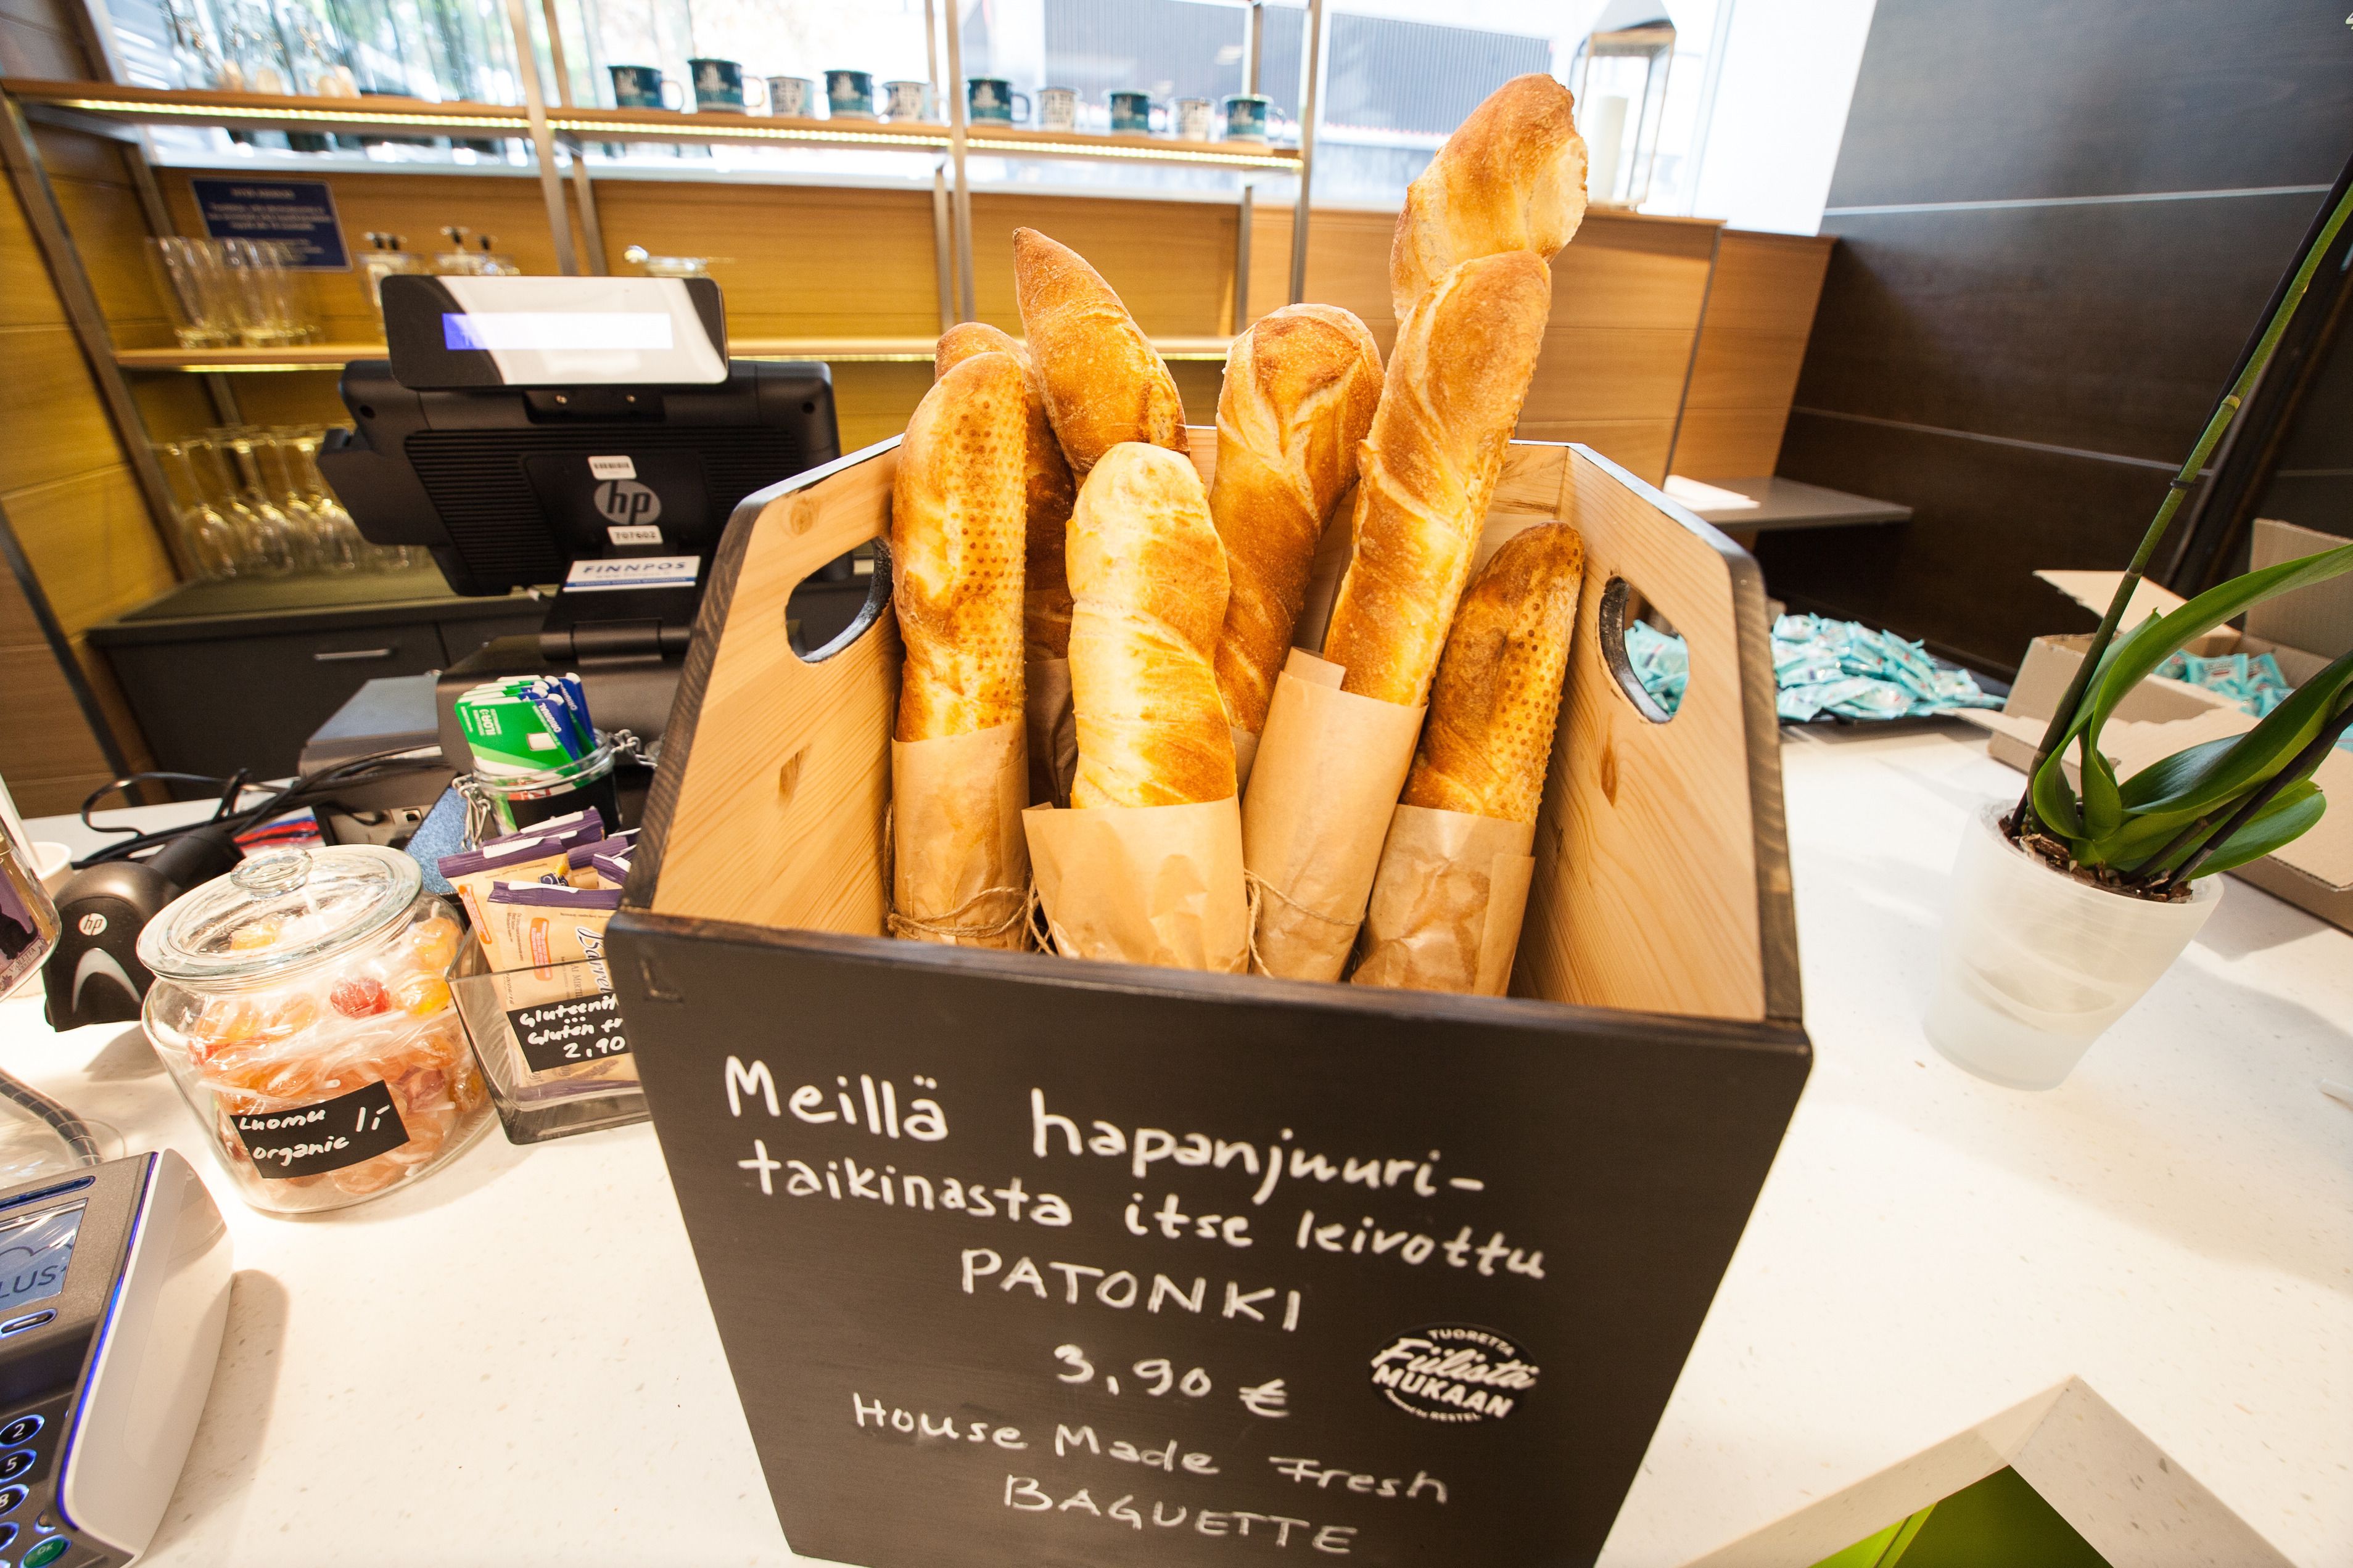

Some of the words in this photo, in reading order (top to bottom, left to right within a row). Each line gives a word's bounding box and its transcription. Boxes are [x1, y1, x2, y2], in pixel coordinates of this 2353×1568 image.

[607, 480, 651, 525] hp
[583, 562, 686, 573] FINNPOS
[538, 702, 562, 733] ORIGINAL
[83, 913, 103, 936] hp
[528, 1024, 595, 1045] Gluten
[562, 1036, 625, 1059] 2,90
[239, 1109, 326, 1130] Luomu
[725, 1055, 949, 1141] Meillä
[1031, 1087, 1485, 1205] hapanjuuri-
[253, 1136, 350, 1167] organic
[738, 1139, 1073, 1226] taikinasta
[1124, 1192, 1253, 1247] itse
[1296, 1210, 1546, 1279] leivottu
[961, 1248, 1301, 1332] PATONKI
[1053, 1344, 1212, 1397] 3,90
[1238, 1378, 1289, 1418] €
[1371, 1363, 1515, 1419] MUKAAN
[12, 1423, 25, 1439] 2
[853, 1392, 1028, 1450] House
[1055, 1424, 1220, 1474] Made
[1268, 1456, 1448, 1504] Fresh
[6, 1457, 18, 1472] 5
[0, 1493, 10, 1508] 8
[1004, 1474, 1358, 1553] BAGUETTE
[36, 1543, 54, 1556] OK
